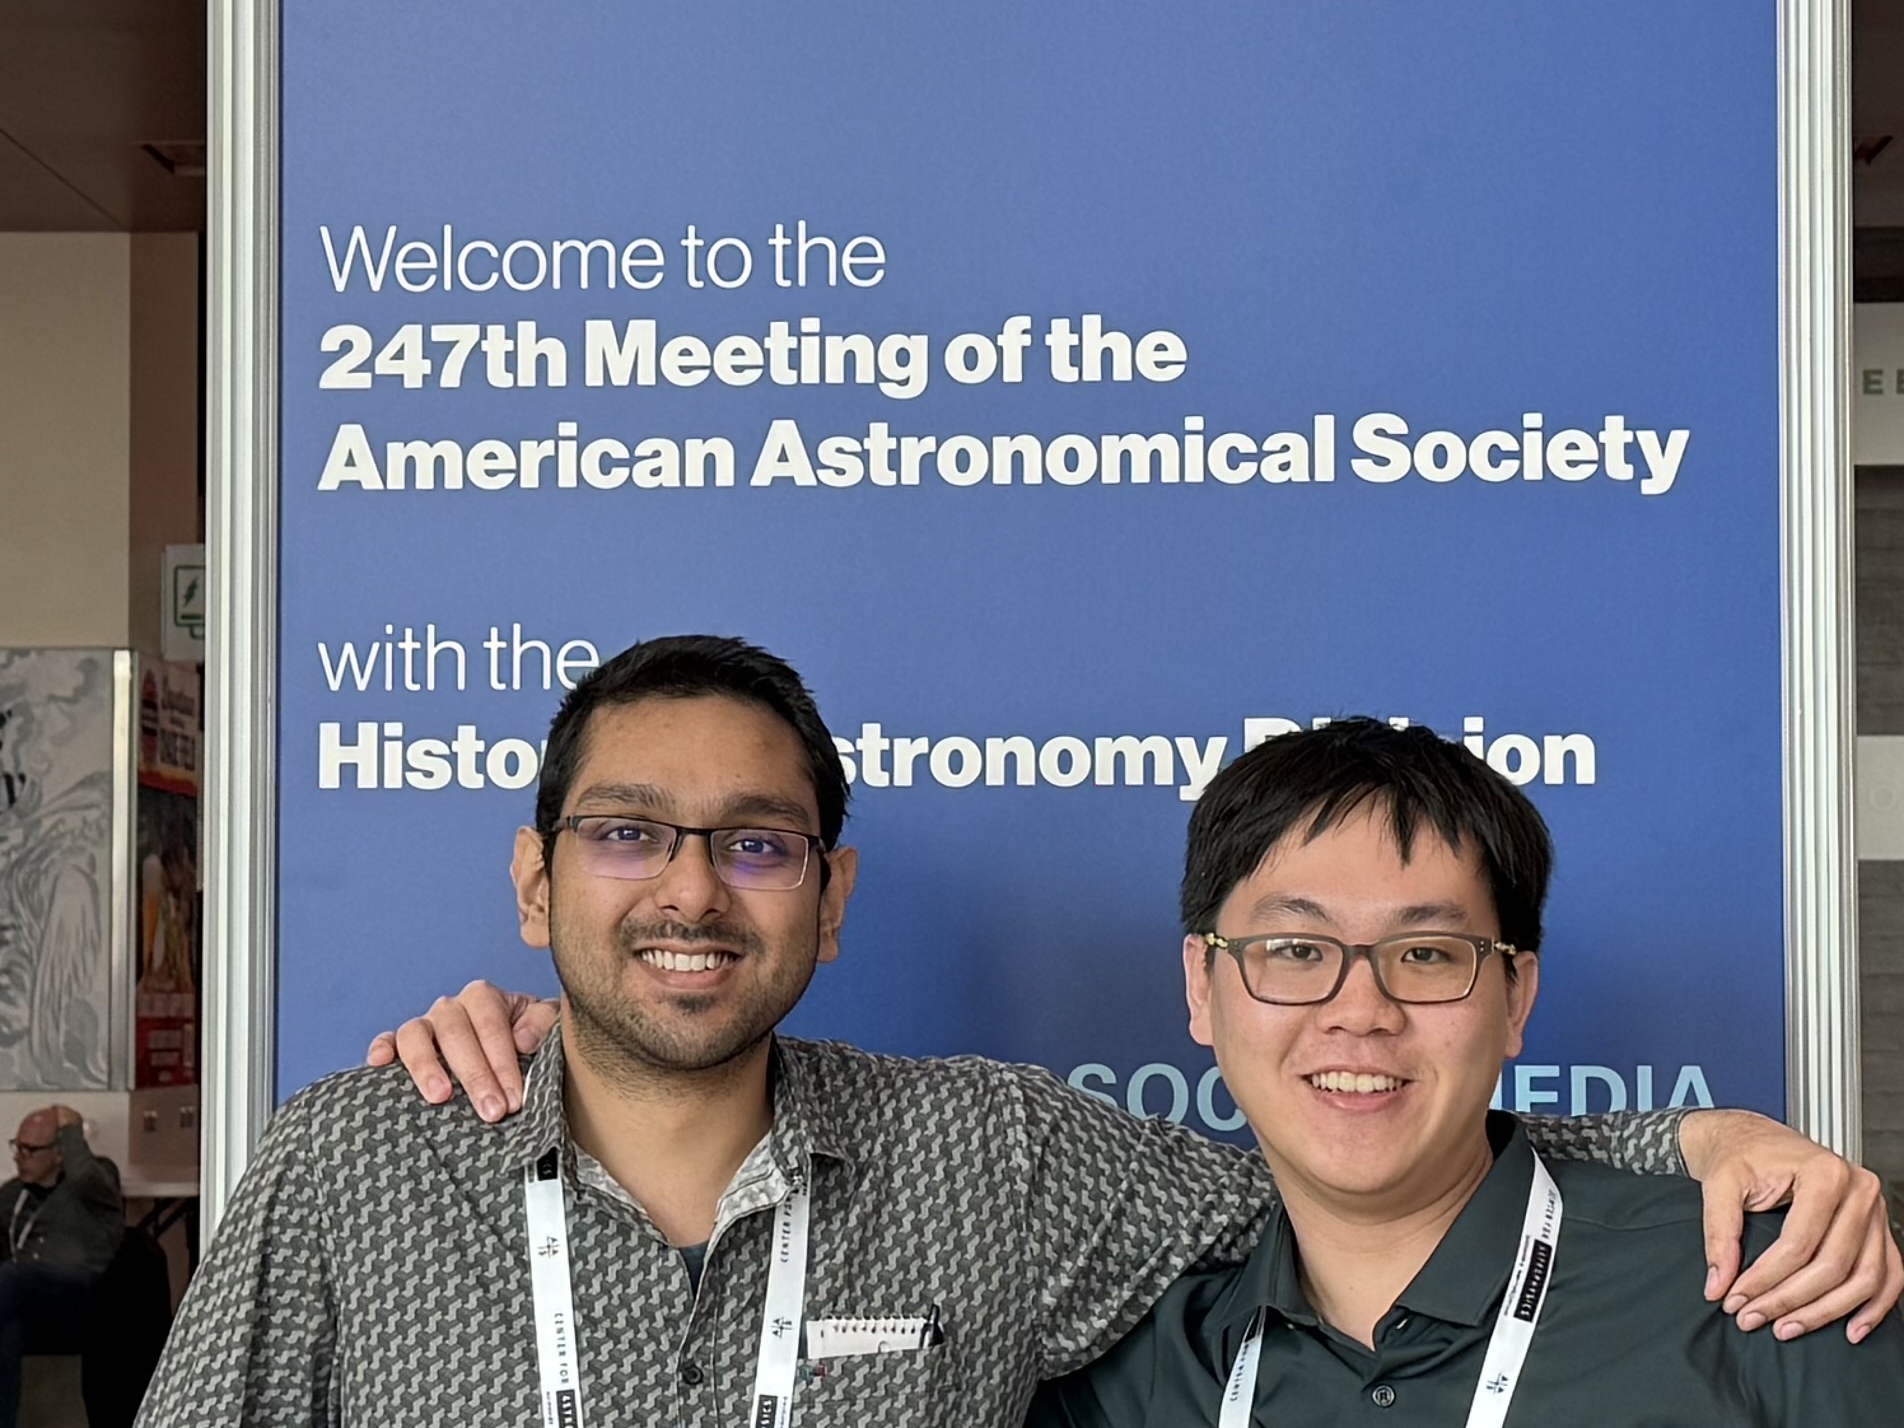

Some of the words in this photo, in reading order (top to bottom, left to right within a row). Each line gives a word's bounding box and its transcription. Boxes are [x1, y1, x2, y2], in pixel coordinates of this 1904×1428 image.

[320, 225, 664, 292] Welcome
[681, 225, 751, 288] to
[769, 220, 885, 286] the
[320, 321, 566, 388] 247th
[586, 318, 928, 399] Meeting
[945, 316, 1031, 383] of
[1045, 315, 1187, 382] the
[318, 422, 734, 490] American
[750, 415, 1334, 487] Astronomical
[1351, 413, 1689, 494] Society
[318, 624, 465, 691] with
[483, 623, 599, 690] the
[319, 722, 547, 789] Histo
[1490, 1064, 1713, 1116] EDIA
